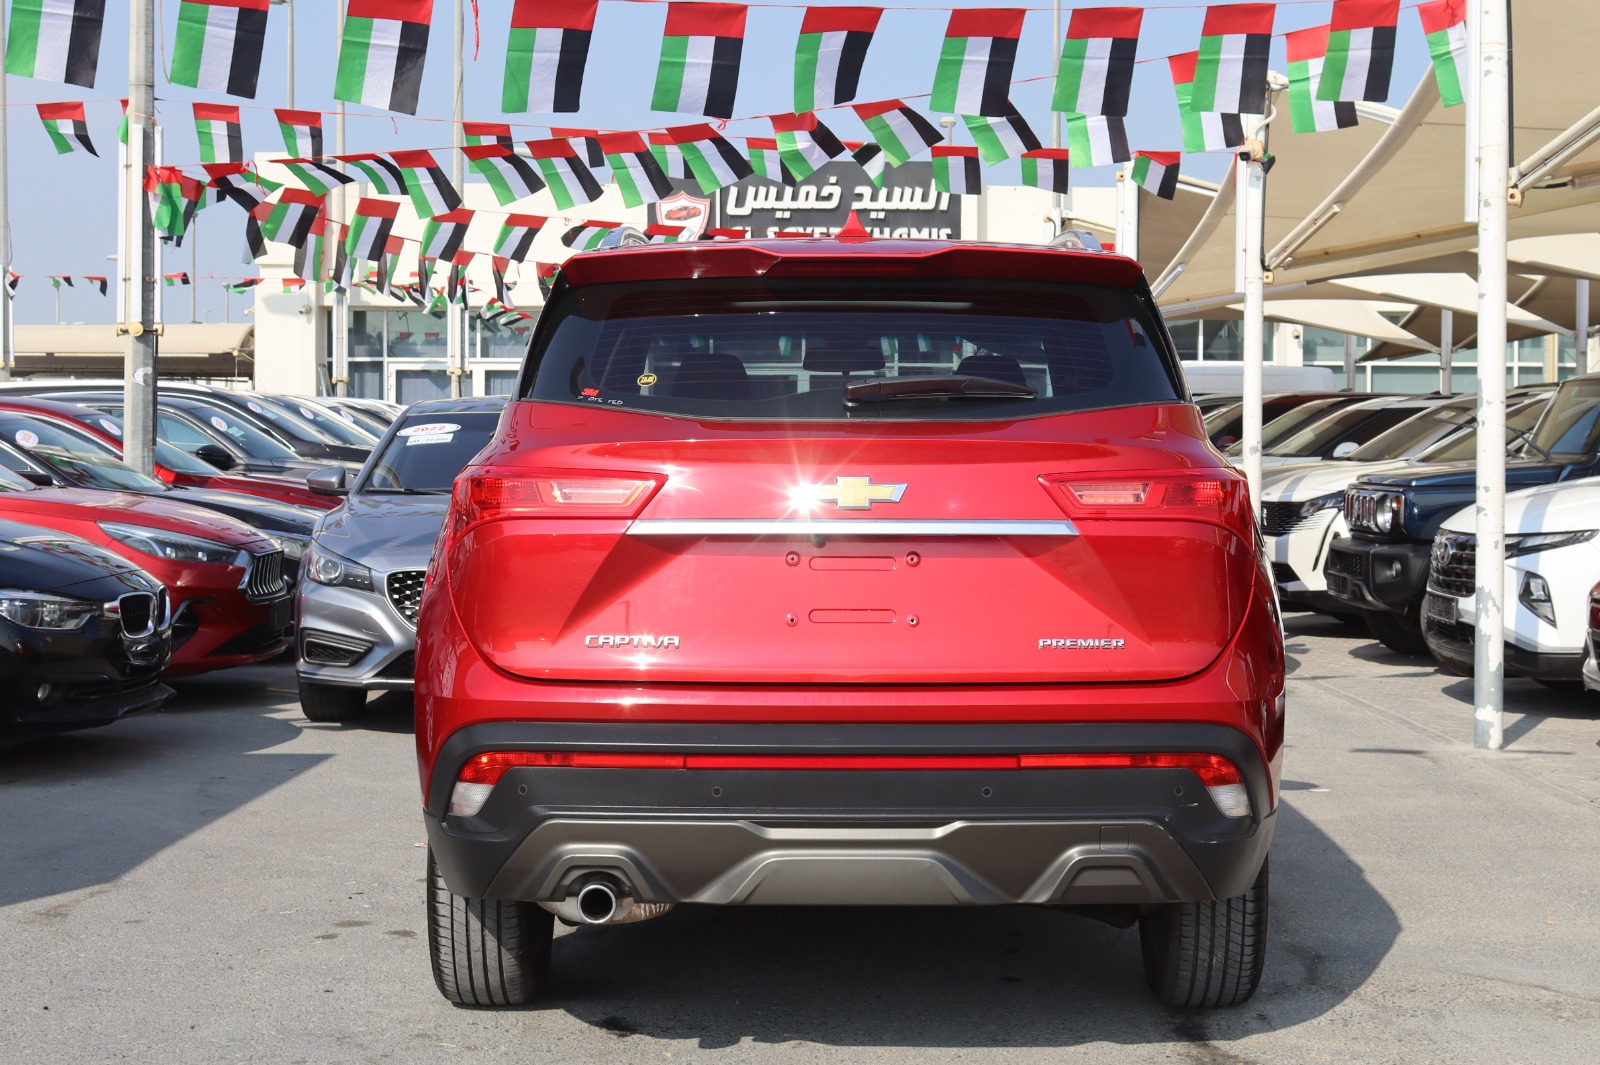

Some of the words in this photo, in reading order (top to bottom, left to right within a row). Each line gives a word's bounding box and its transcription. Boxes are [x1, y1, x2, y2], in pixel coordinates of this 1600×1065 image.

[726, 176, 841, 219] خميس
[851, 178, 950, 219] السيد
[581, 388, 599, 396] 3M
[585, 635, 680, 649] CAPTIVA
[1038, 638, 1125, 650] PREMIER
